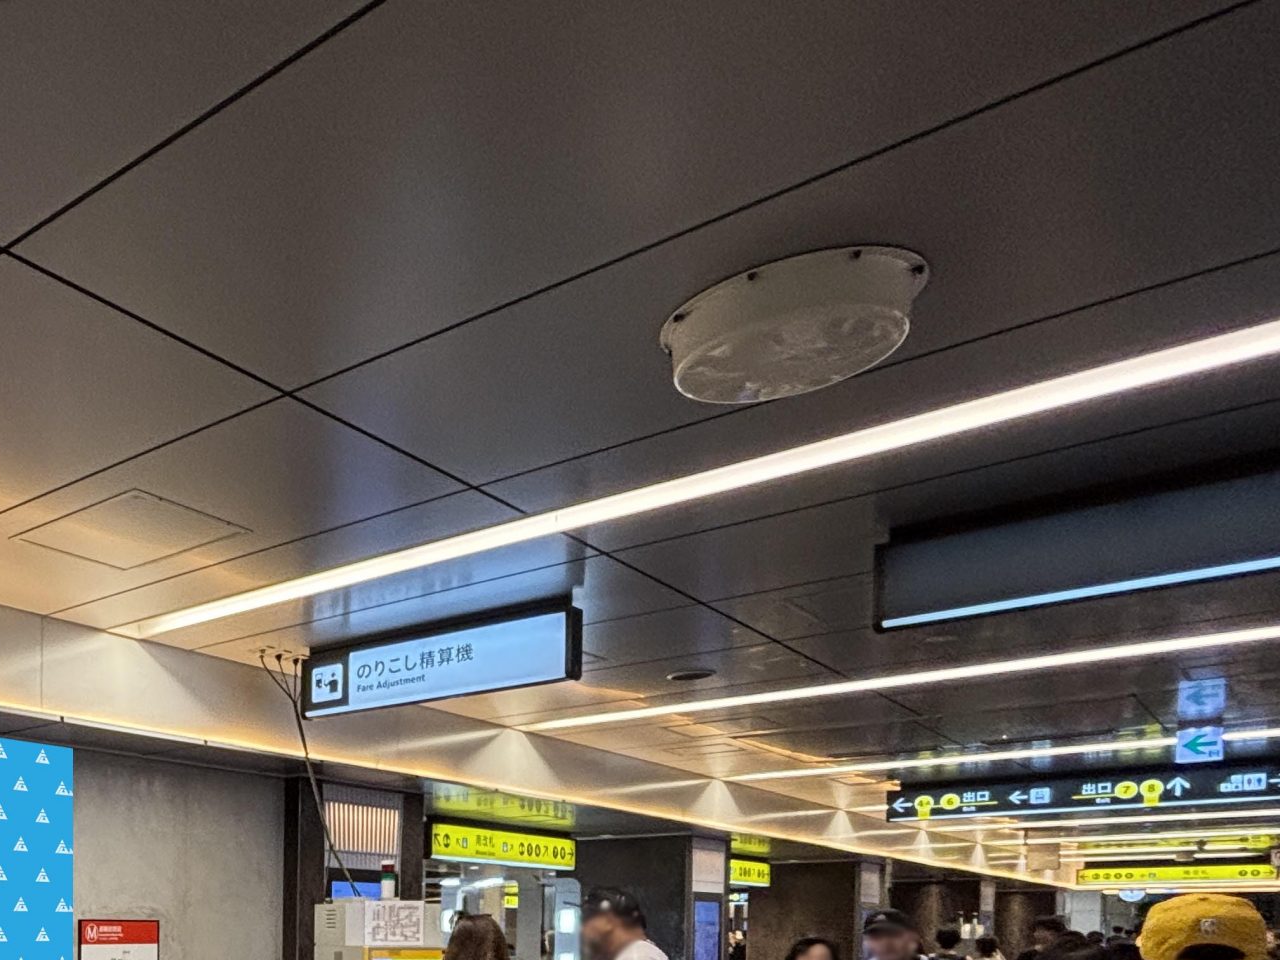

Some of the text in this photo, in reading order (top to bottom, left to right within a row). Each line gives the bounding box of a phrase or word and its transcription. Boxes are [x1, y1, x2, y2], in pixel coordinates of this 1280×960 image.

[357, 643, 474, 679] のりこし精算機
[357, 674, 426, 693] Fare Adjustment
[1081, 781, 1112, 795] 出口
[962, 790, 990, 803] 出口
